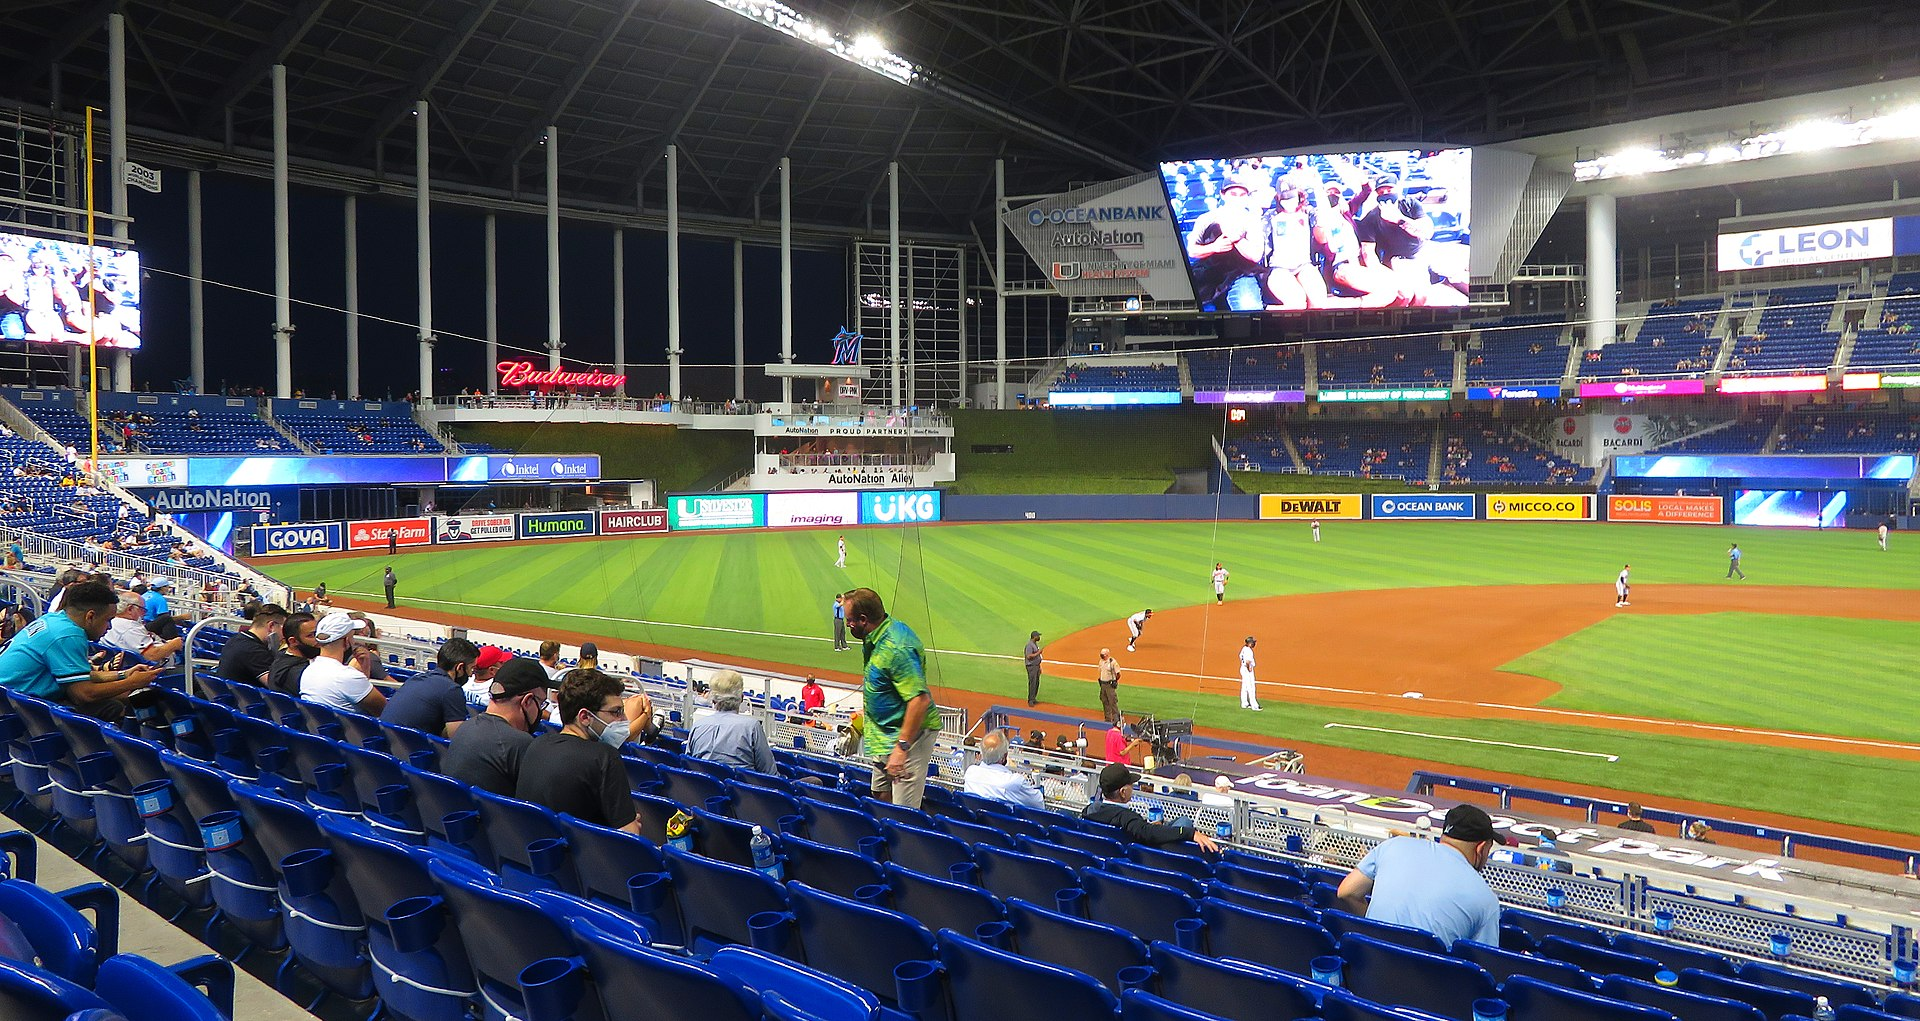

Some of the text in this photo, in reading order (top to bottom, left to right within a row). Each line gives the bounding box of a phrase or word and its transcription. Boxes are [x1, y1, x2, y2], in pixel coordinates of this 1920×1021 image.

[131, 165, 155, 180] 2003
[1051, 229, 1144, 247] AutoNation
[1778, 227, 1869, 254] LEON
[1146, 260, 1175, 269] MIAMI
[496, 361, 626, 387] Budweiser
[1501, 388, 1538, 399] Fanatics
[785, 427, 819, 435] AutoNation
[1603, 435, 1643, 447] BACARDÍ
[515, 463, 539, 475] Inktel
[563, 463, 587, 475] Inktel
[828, 473, 914, 486] AutoNation Alley
[156, 488, 271, 508] AutoNation
[1397, 501, 1464, 512] OCEAN BANK
[1509, 502, 1575, 512] MICCO.CO
[1614, 500, 1652, 512] SOLIS
[790, 514, 843, 525] imaging
[270, 529, 325, 549] GOYA
[1587, 837, 1785, 882] park
